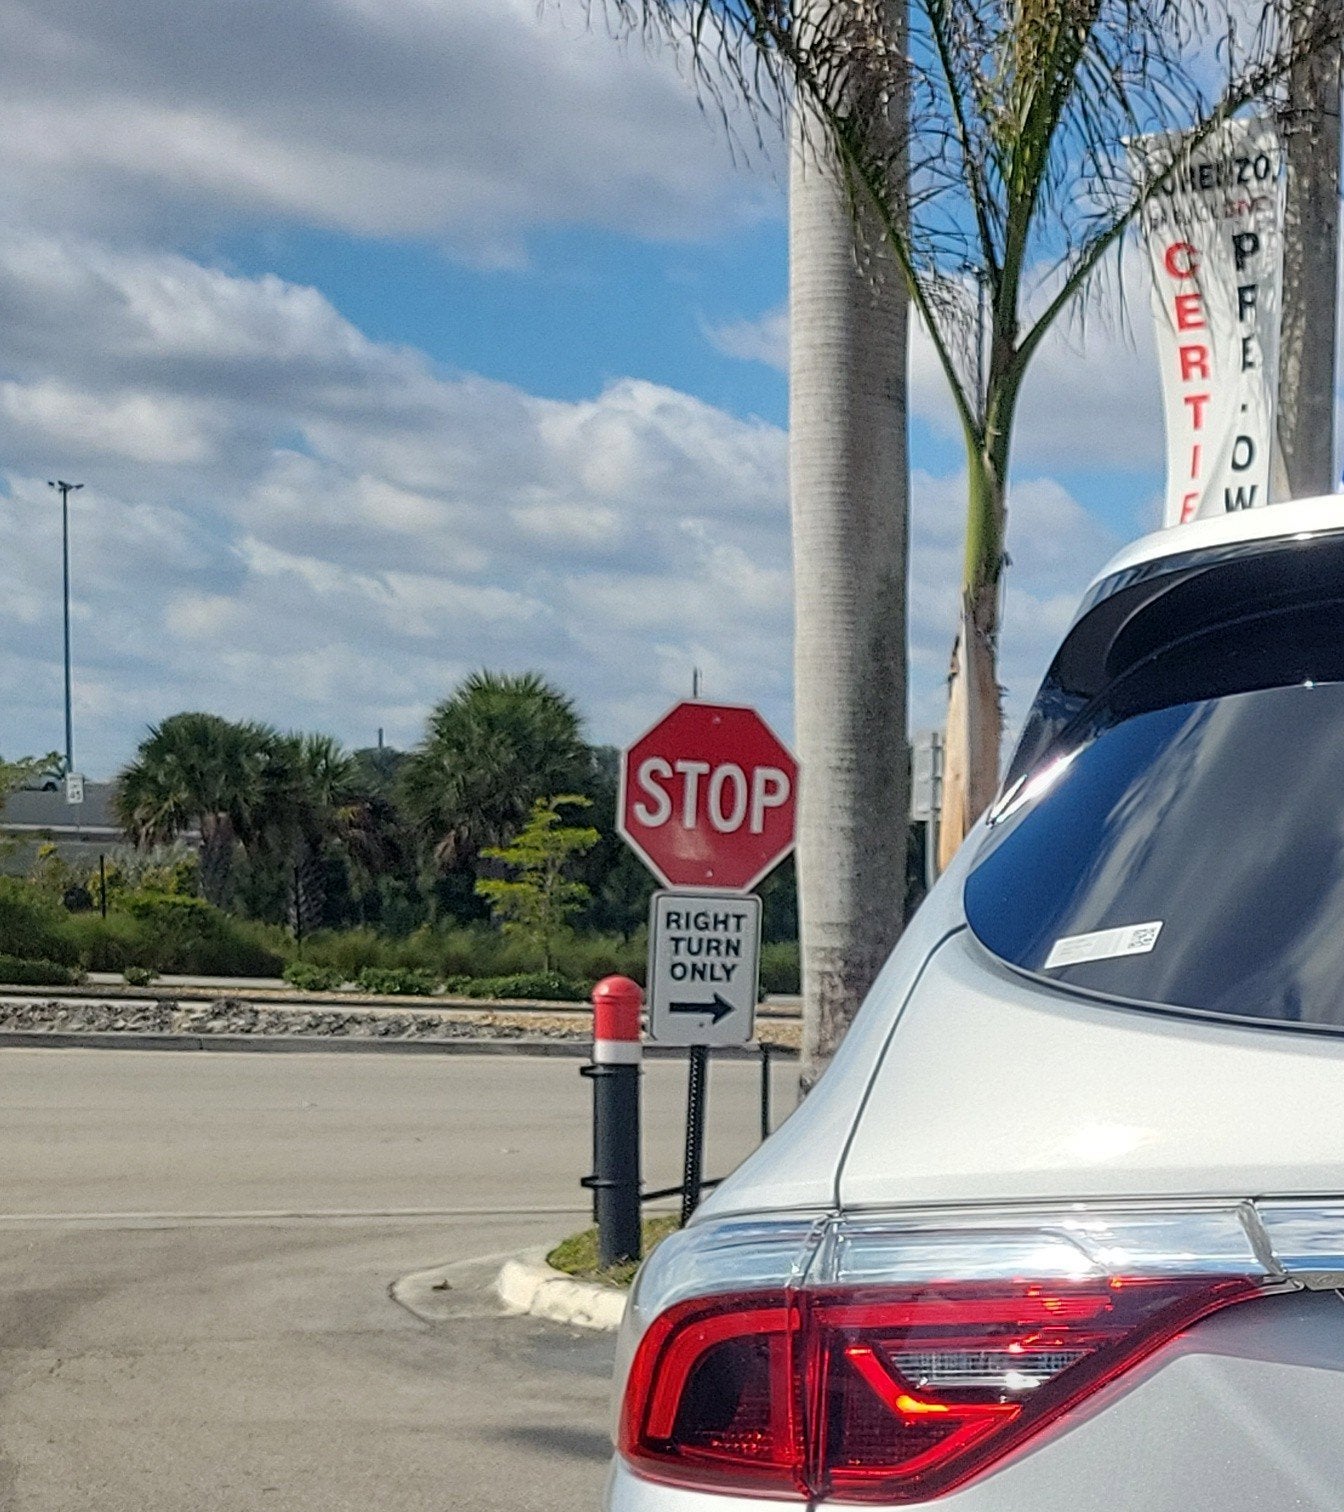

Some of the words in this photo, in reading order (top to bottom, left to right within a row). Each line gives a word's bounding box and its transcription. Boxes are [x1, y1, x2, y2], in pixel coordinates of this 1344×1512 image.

[634, 756, 790, 834] STOP
[666, 911, 748, 932] RIGHT
[670, 936, 742, 958] TURN
[669, 962, 738, 982] ONLY
